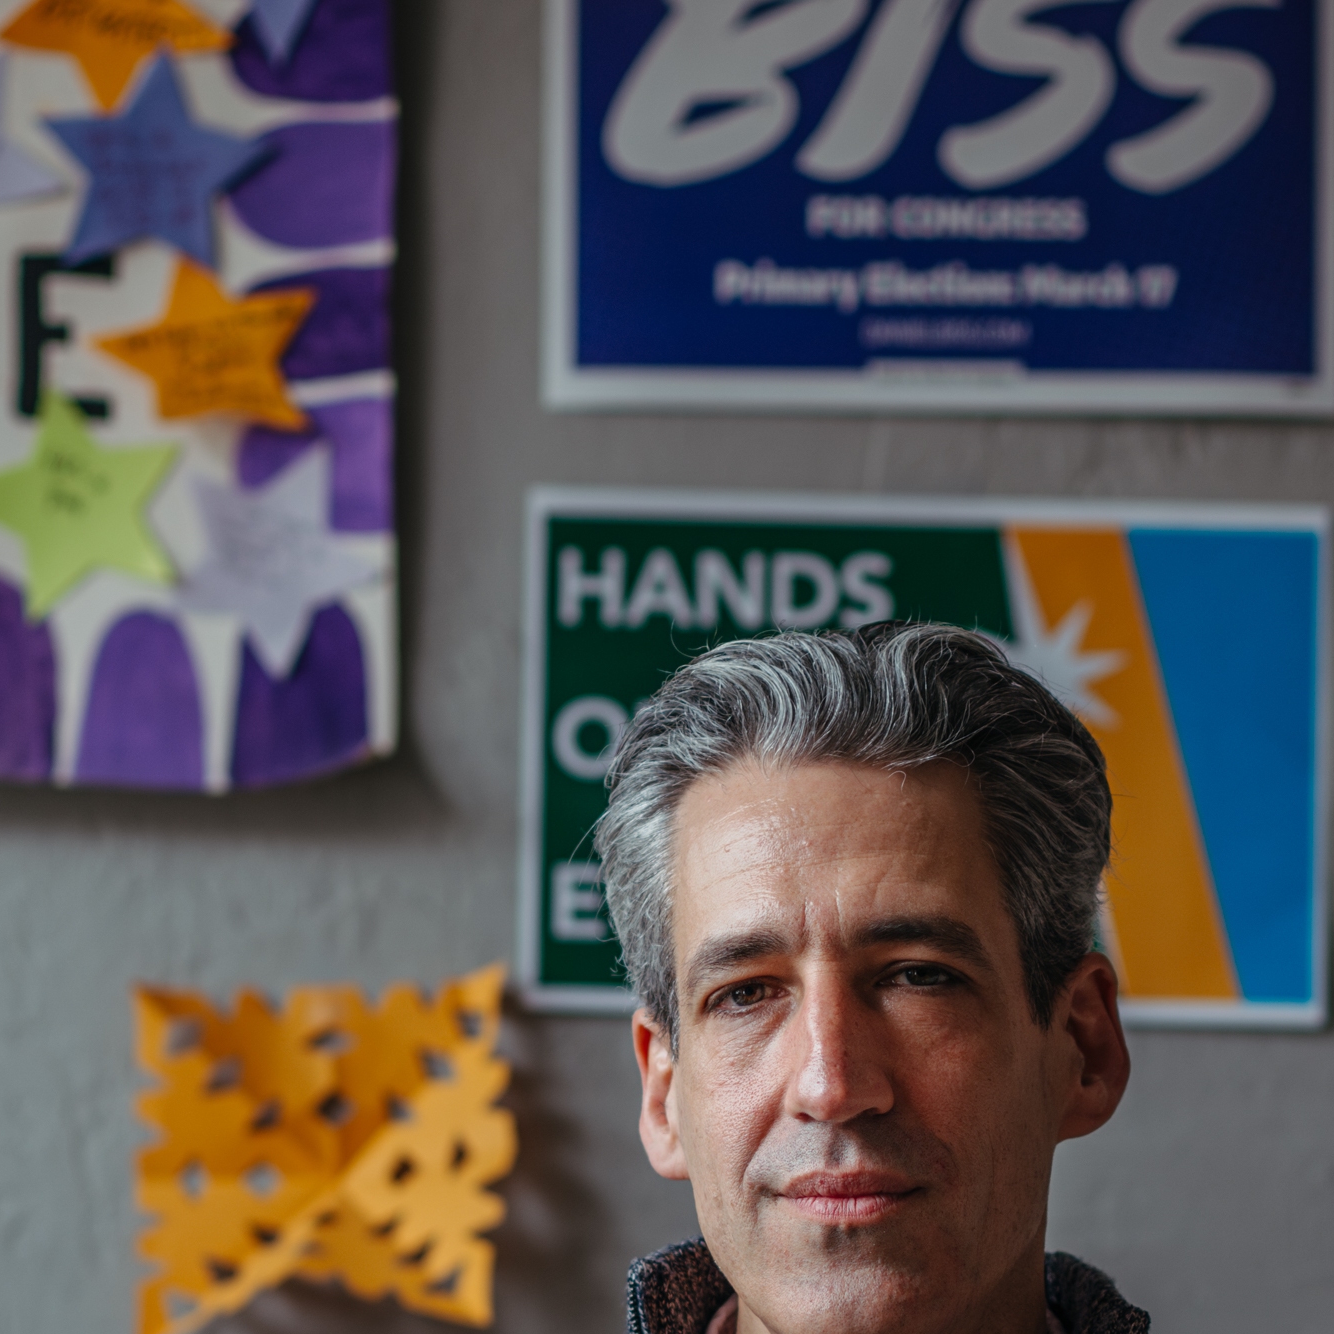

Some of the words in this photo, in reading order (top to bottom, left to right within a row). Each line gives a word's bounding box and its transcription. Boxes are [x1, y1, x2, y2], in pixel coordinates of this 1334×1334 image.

[601, 0, 1279, 194] BISS
[805, 197, 883, 238] FOR
[892, 197, 1087, 241] CONGRESS
[713, 259, 859, 311] Primary
[866, 261, 1013, 306] Election
[1022, 263, 1131, 307] March
[557, 546, 894, 628] HANDS
